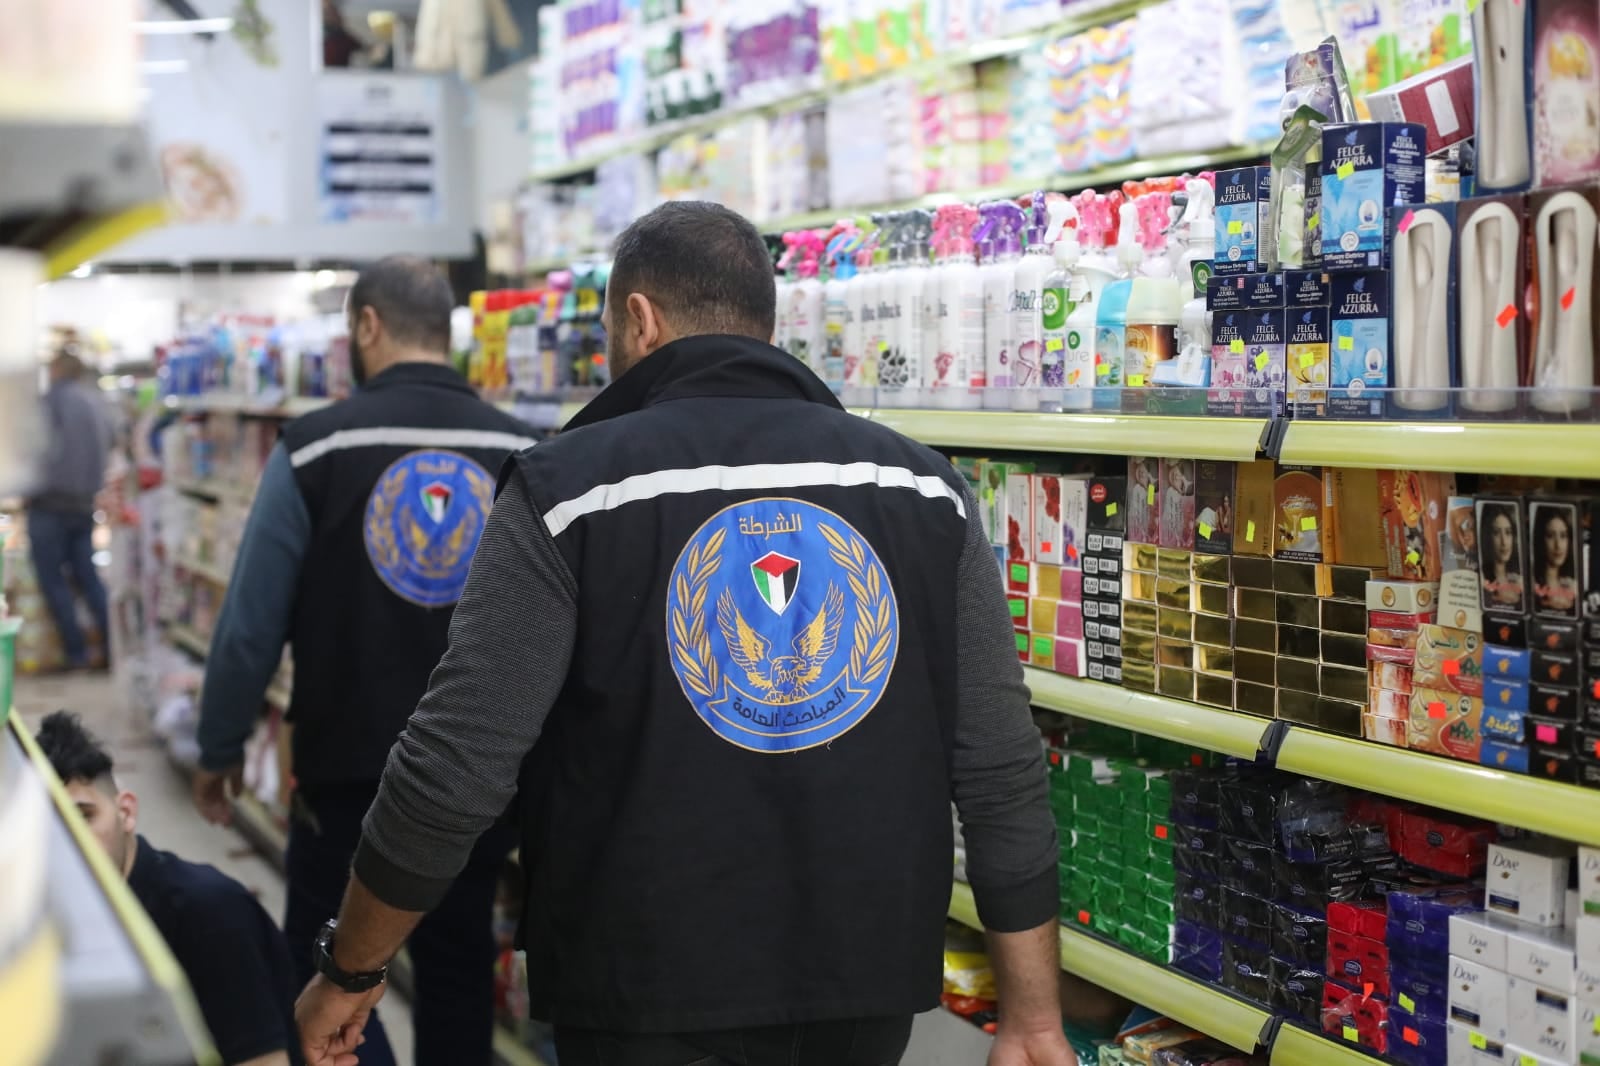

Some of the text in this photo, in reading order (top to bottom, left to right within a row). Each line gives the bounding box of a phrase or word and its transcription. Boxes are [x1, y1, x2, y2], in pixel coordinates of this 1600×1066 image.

[1337, 145, 1366, 157] FELCE
[1225, 184, 1246, 194] FELCE
[1220, 192, 1250, 203] AZZURRA
[1346, 294, 1372, 303] FELCE
[1339, 303, 1378, 314] AZZURRA
[1221, 326, 1238, 335] FELCE
[1256, 325, 1275, 334] FELCE
[1297, 324, 1318, 333] FELCE
[1251, 333, 1280, 342] AZZURRA
[1292, 332, 1323, 342] AZZURRA
[739, 512, 802, 540] الشرطة
[732, 686, 846, 728] المباحث العامة
[1492, 852, 1520, 872] Dove
[1468, 933, 1488, 948] Dove
[1529, 954, 1550, 968] Dove
[1453, 966, 1479, 982] Dove
